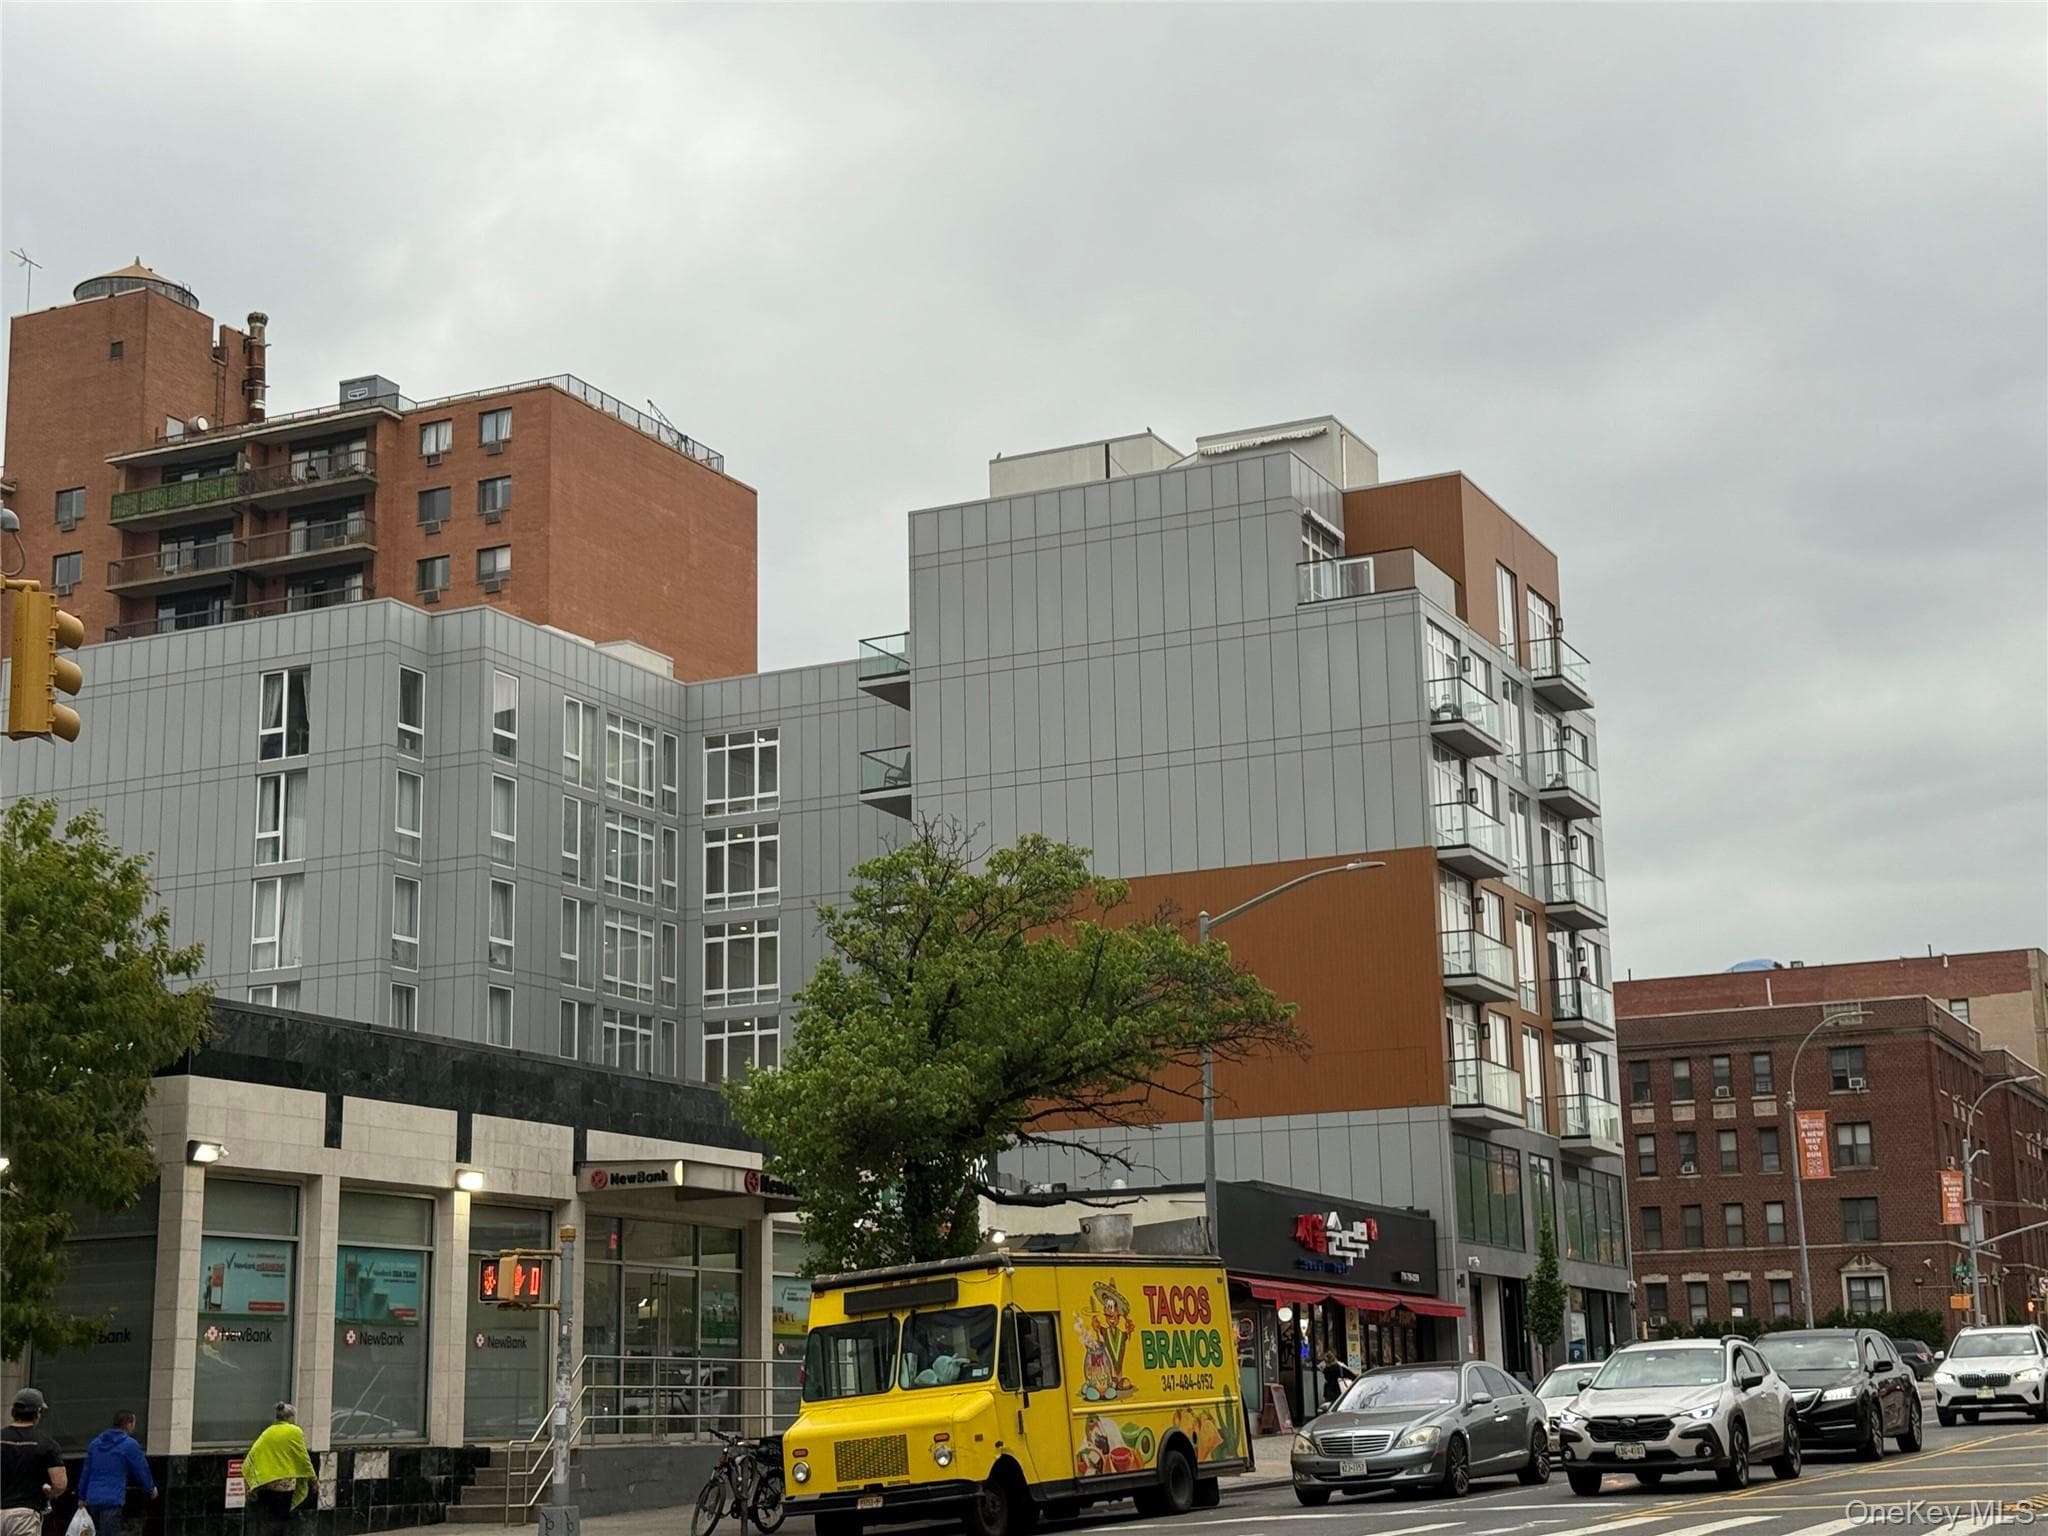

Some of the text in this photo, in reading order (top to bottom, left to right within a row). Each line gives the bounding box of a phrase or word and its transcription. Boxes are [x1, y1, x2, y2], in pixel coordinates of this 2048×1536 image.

[610, 1169, 669, 1185] NewBank
[1143, 1285, 1212, 1325] TACOS
[221, 1327, 273, 1342] NewBank
[359, 1331, 405, 1346] NewBank
[487, 1335, 528, 1349] NewBank
[1141, 1329, 1224, 1370] BRAVOS
[1161, 1373, 1214, 1392] 347-484-6952
